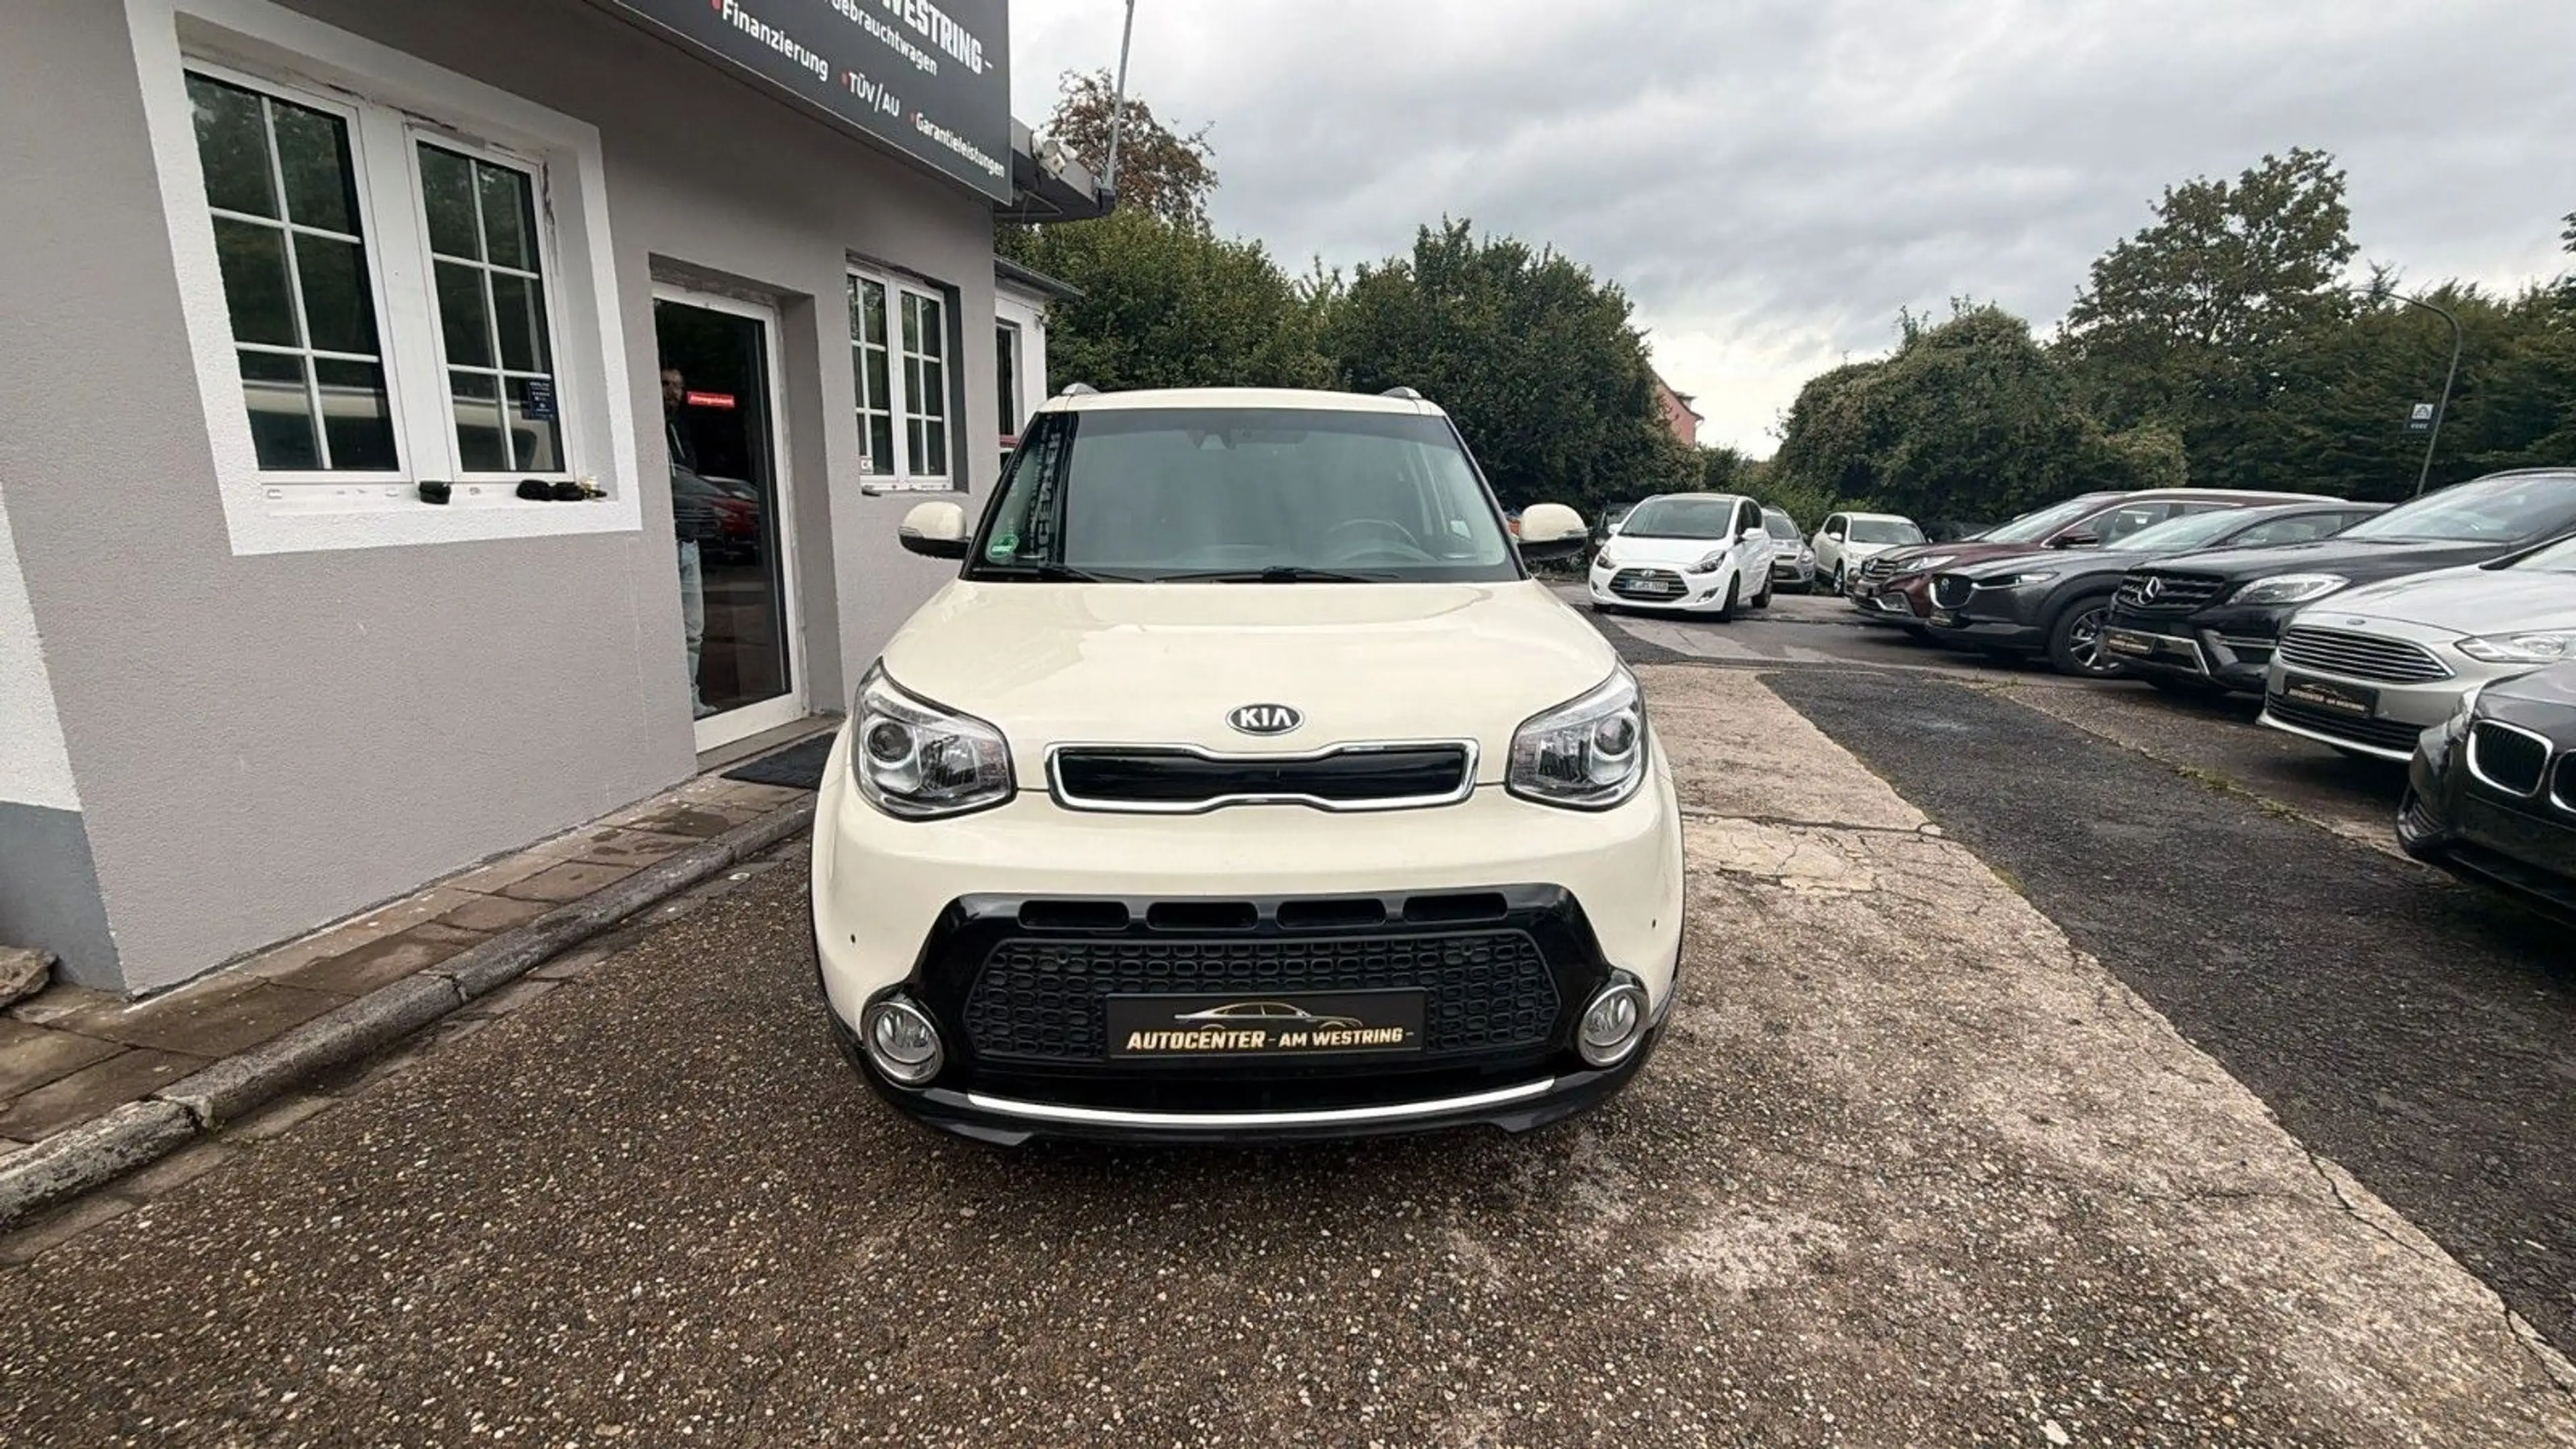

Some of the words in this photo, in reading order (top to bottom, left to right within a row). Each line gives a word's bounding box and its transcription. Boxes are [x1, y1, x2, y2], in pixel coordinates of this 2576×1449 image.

[722, 0, 829, 83] Finanzierung
[848, 71, 900, 117] TÜV/AU
[915, 111, 1006, 179] Garantieleistungen
[1239, 706, 1293, 727] KIA
[1126, 1029, 1266, 1051] AUTOCENTER
[1278, 1031, 1307, 1047] AM
[1312, 1027, 1403, 1046] WESTRING
